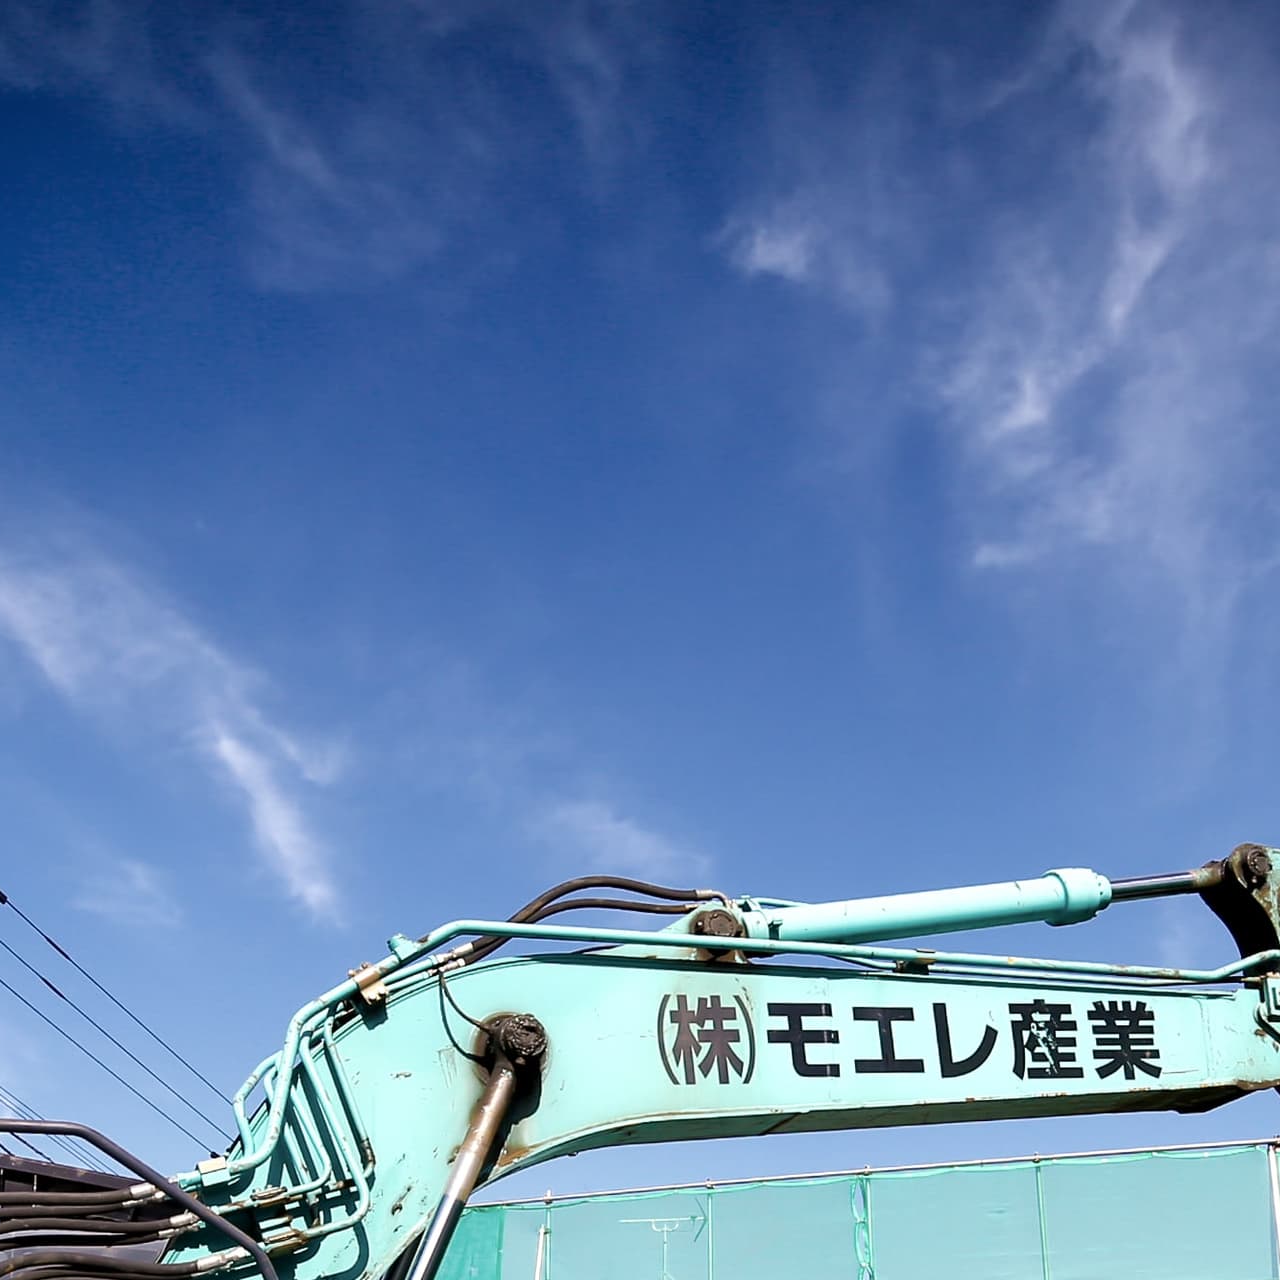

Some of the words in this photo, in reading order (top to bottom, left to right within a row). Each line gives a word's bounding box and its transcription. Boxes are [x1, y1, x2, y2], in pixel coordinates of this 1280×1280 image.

[657, 993, 1163, 1086] (株)モエレ産業
